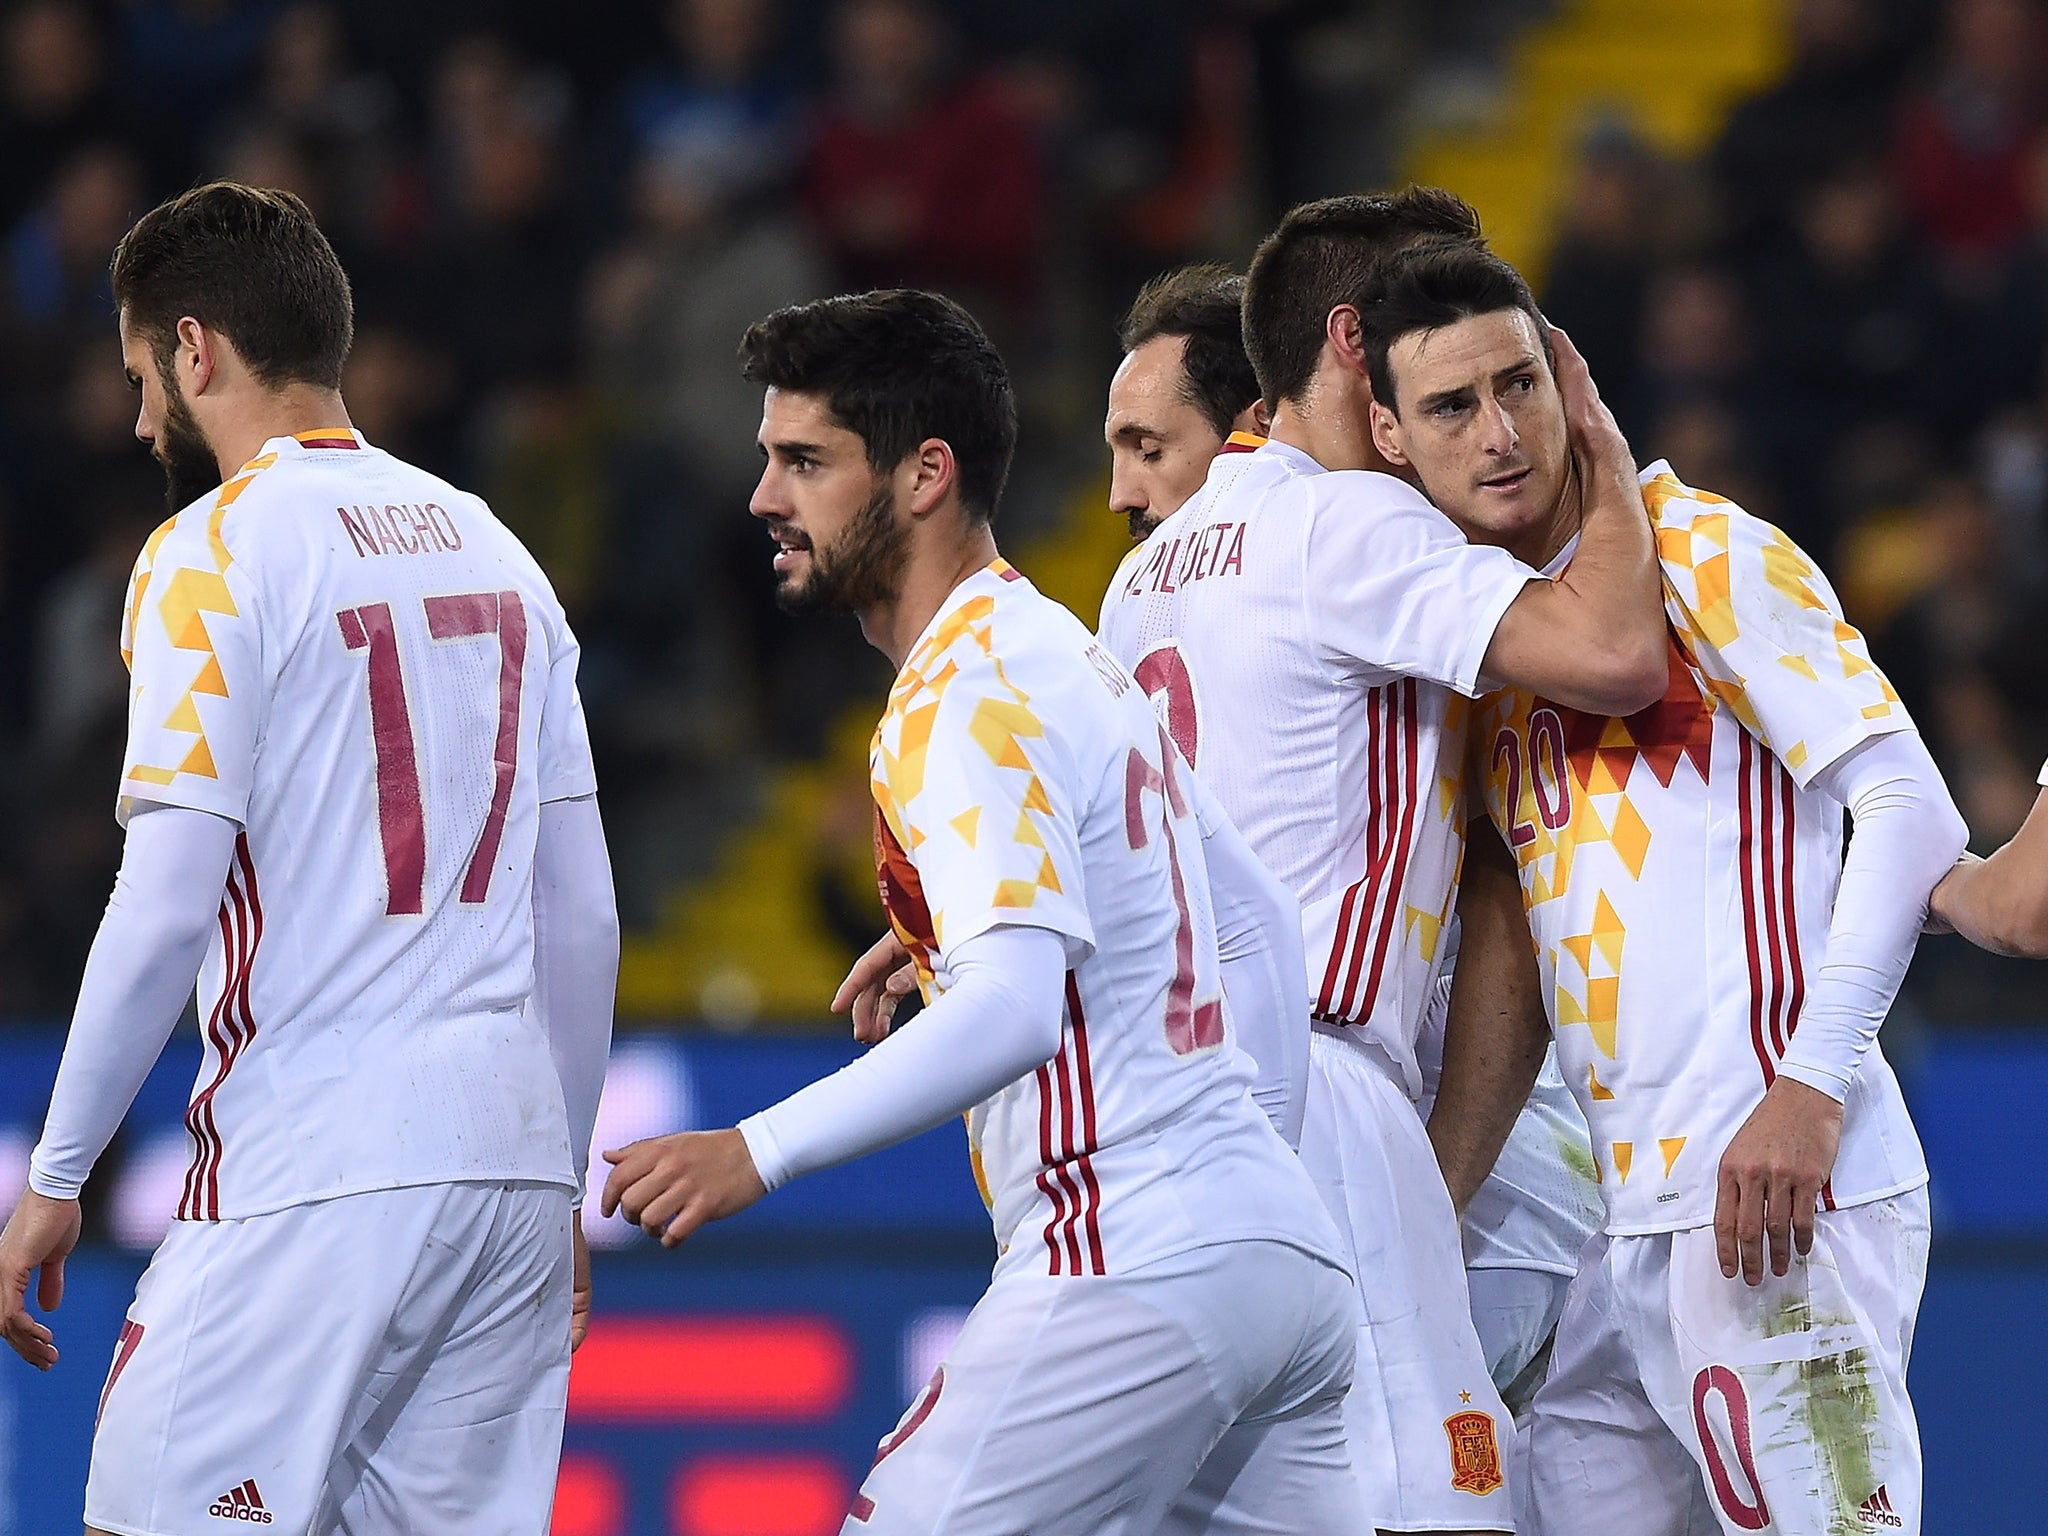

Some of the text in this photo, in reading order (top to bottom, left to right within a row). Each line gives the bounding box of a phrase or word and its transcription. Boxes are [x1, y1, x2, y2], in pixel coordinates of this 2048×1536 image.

[337, 503, 462, 558] NACHO
[335, 590, 528, 917] 17
[1491, 708, 1573, 849] 20
[209, 1502, 273, 1524] adidas
[1857, 1509, 1903, 1528] adidas
